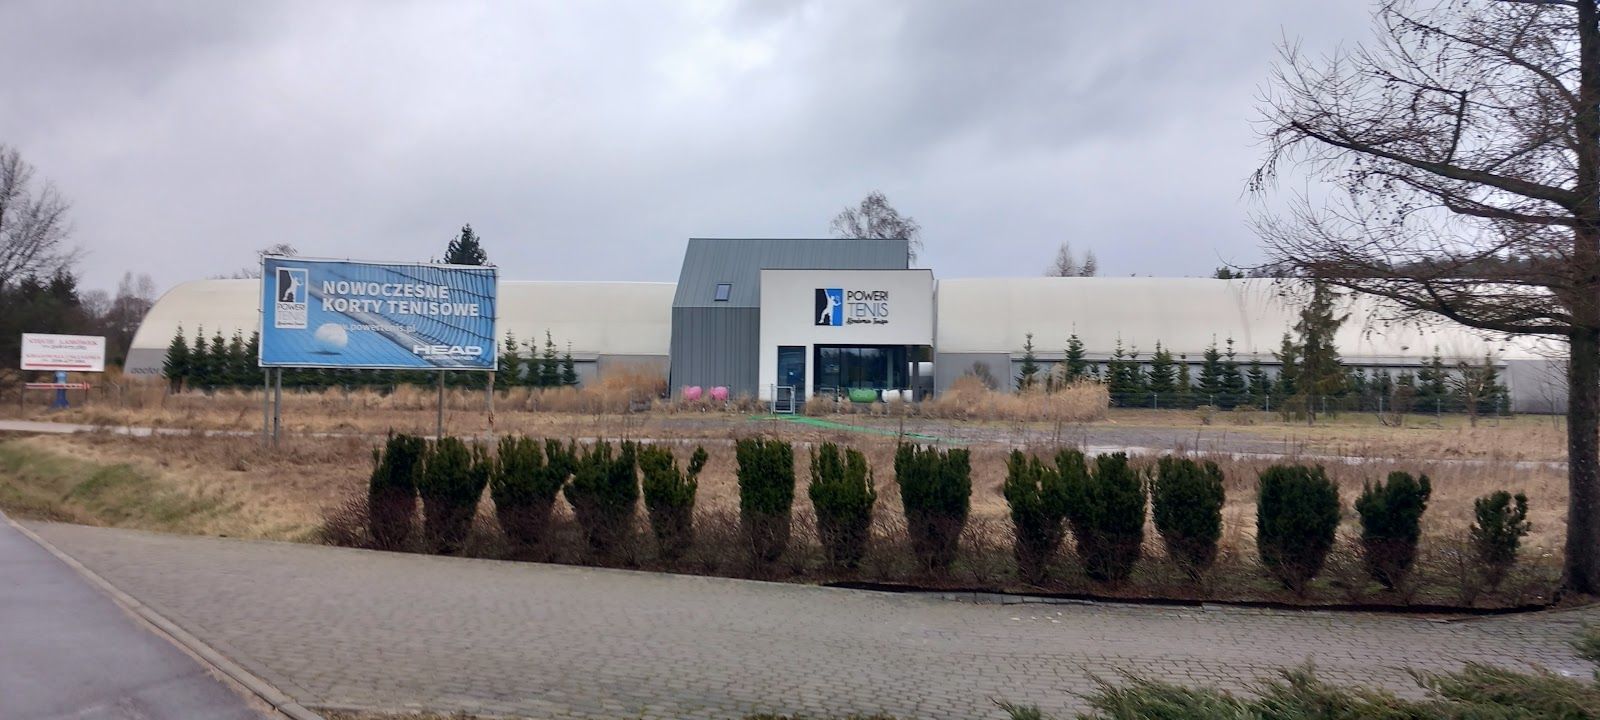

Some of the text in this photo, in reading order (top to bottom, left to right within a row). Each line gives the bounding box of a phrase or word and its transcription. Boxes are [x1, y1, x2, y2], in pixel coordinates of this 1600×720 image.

[322, 280, 449, 299] NOWOCZESNE
[322, 298, 479, 317] KORTY TENISOWE
[847, 303, 889, 317] TENIS
[413, 345, 482, 355] HEAD
